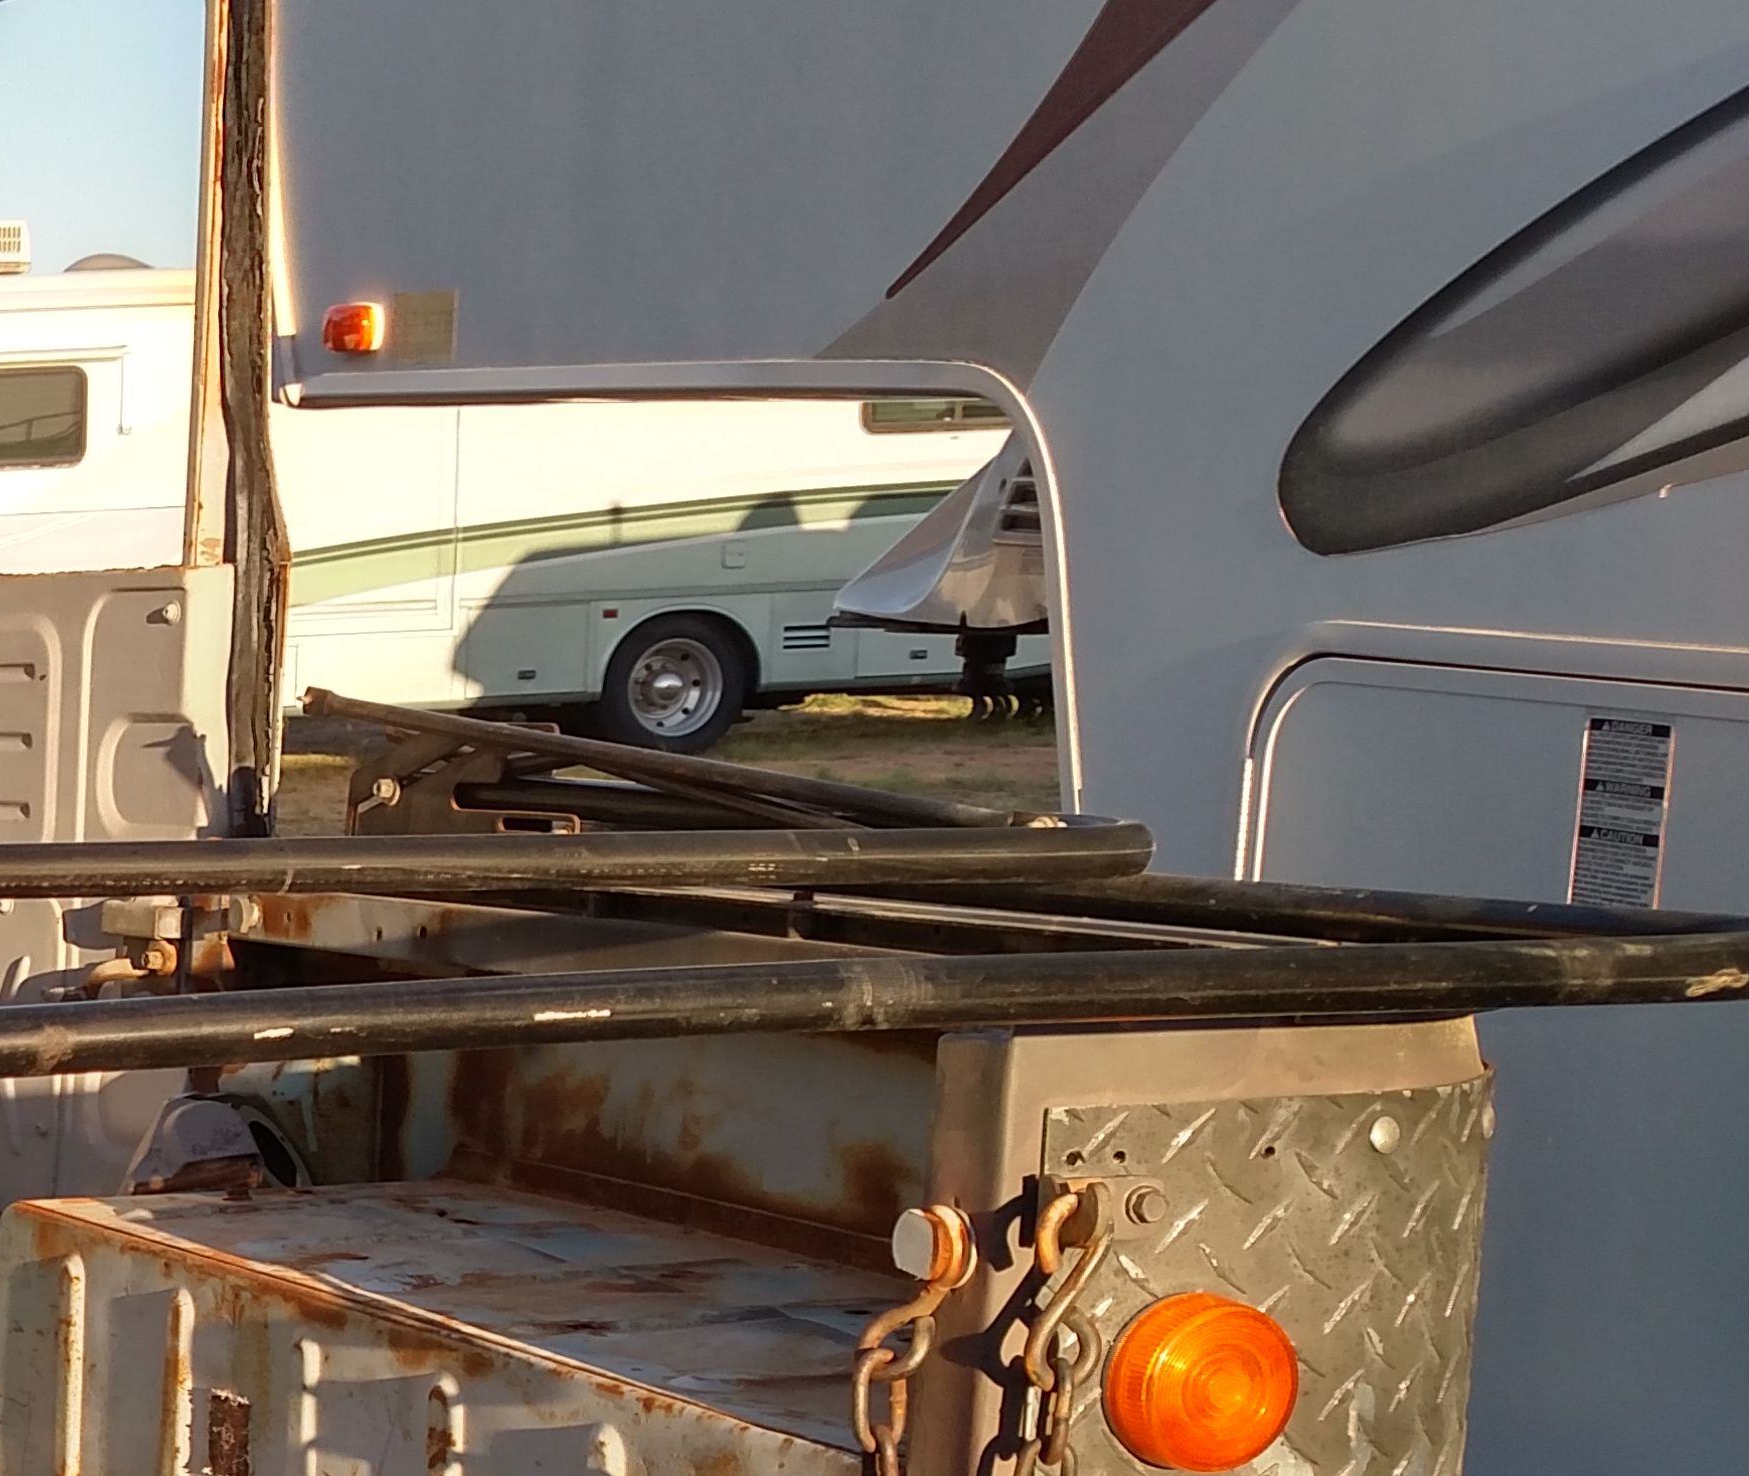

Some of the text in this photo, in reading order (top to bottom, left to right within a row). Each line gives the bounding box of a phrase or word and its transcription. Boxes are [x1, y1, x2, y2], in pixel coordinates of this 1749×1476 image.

[1611, 721, 1653, 736] DANGER
[1605, 782, 1652, 798] WARNING
[1600, 829, 1644, 846] CAUTION
